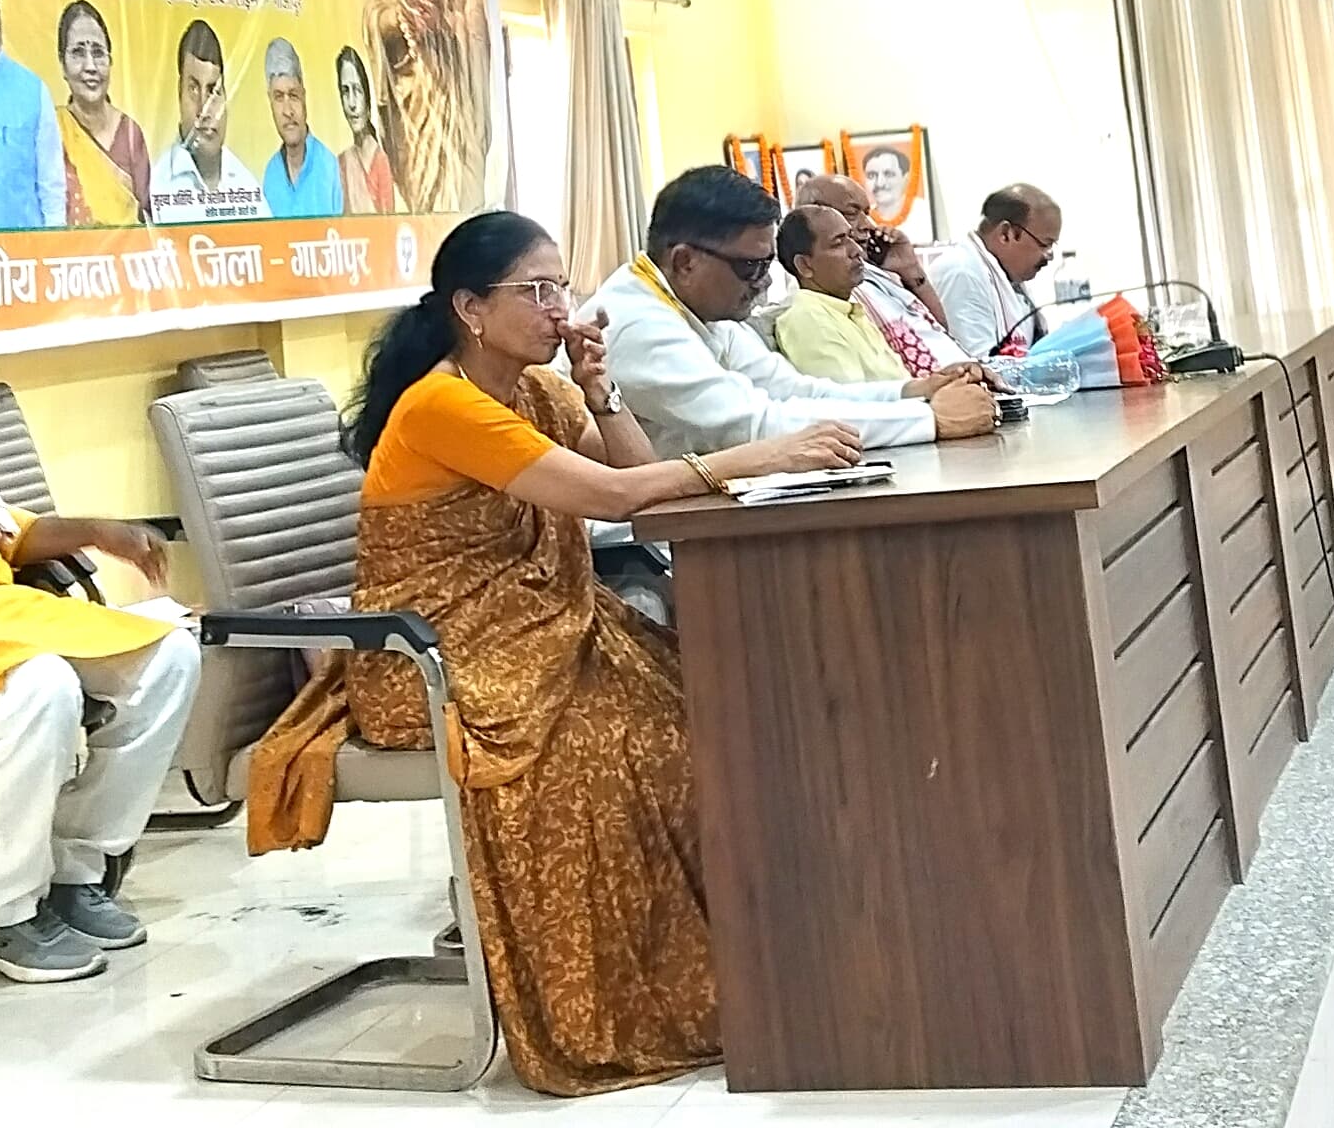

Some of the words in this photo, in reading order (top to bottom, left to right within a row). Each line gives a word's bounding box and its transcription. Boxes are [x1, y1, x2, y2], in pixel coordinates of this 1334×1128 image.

[42, 255, 122, 301] जनता
[188, 233, 265, 287] जिला
[288, 226, 372, 287] गाजीपुर
